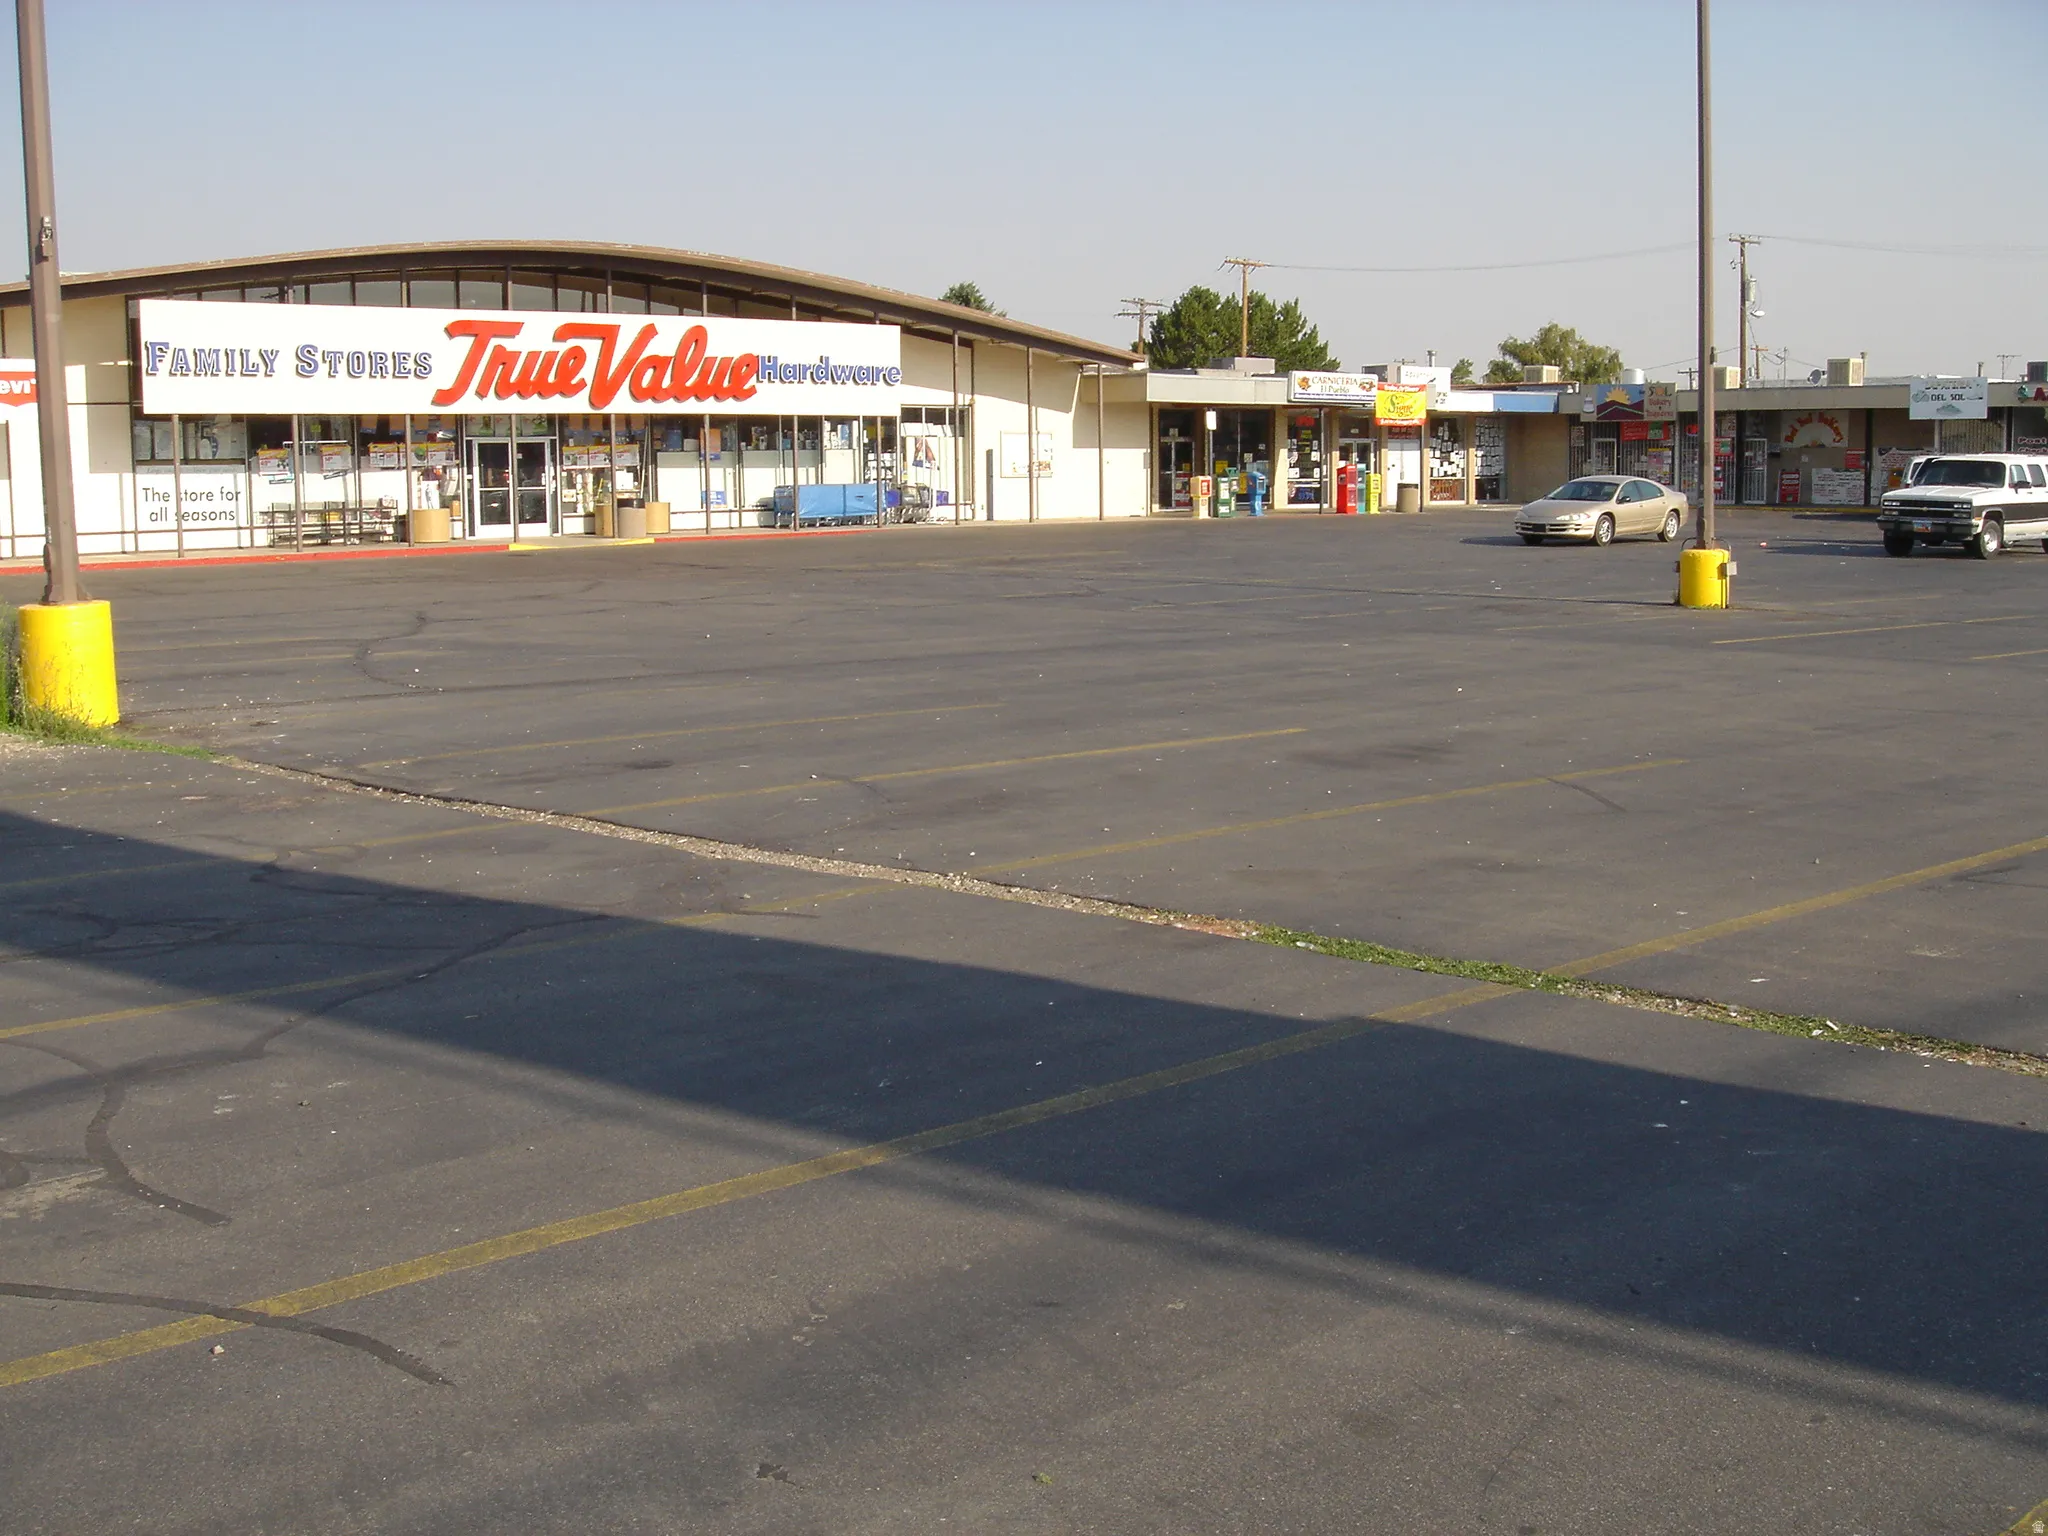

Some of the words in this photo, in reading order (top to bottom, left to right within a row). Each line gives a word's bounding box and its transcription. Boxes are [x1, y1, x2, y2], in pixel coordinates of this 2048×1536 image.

[145, 340, 279, 377] FAMILY
[296, 343, 433, 379] STORES
[431, 320, 588, 406] True
[552, 322, 759, 410] Value
[757, 355, 902, 386] Hardware
[1930, 393, 1947, 402] DEL
[1950, 393, 1966, 401] SOL
[142, 486, 171, 502] The
[220, 486, 241, 502] for
[149, 507, 168, 522] all
